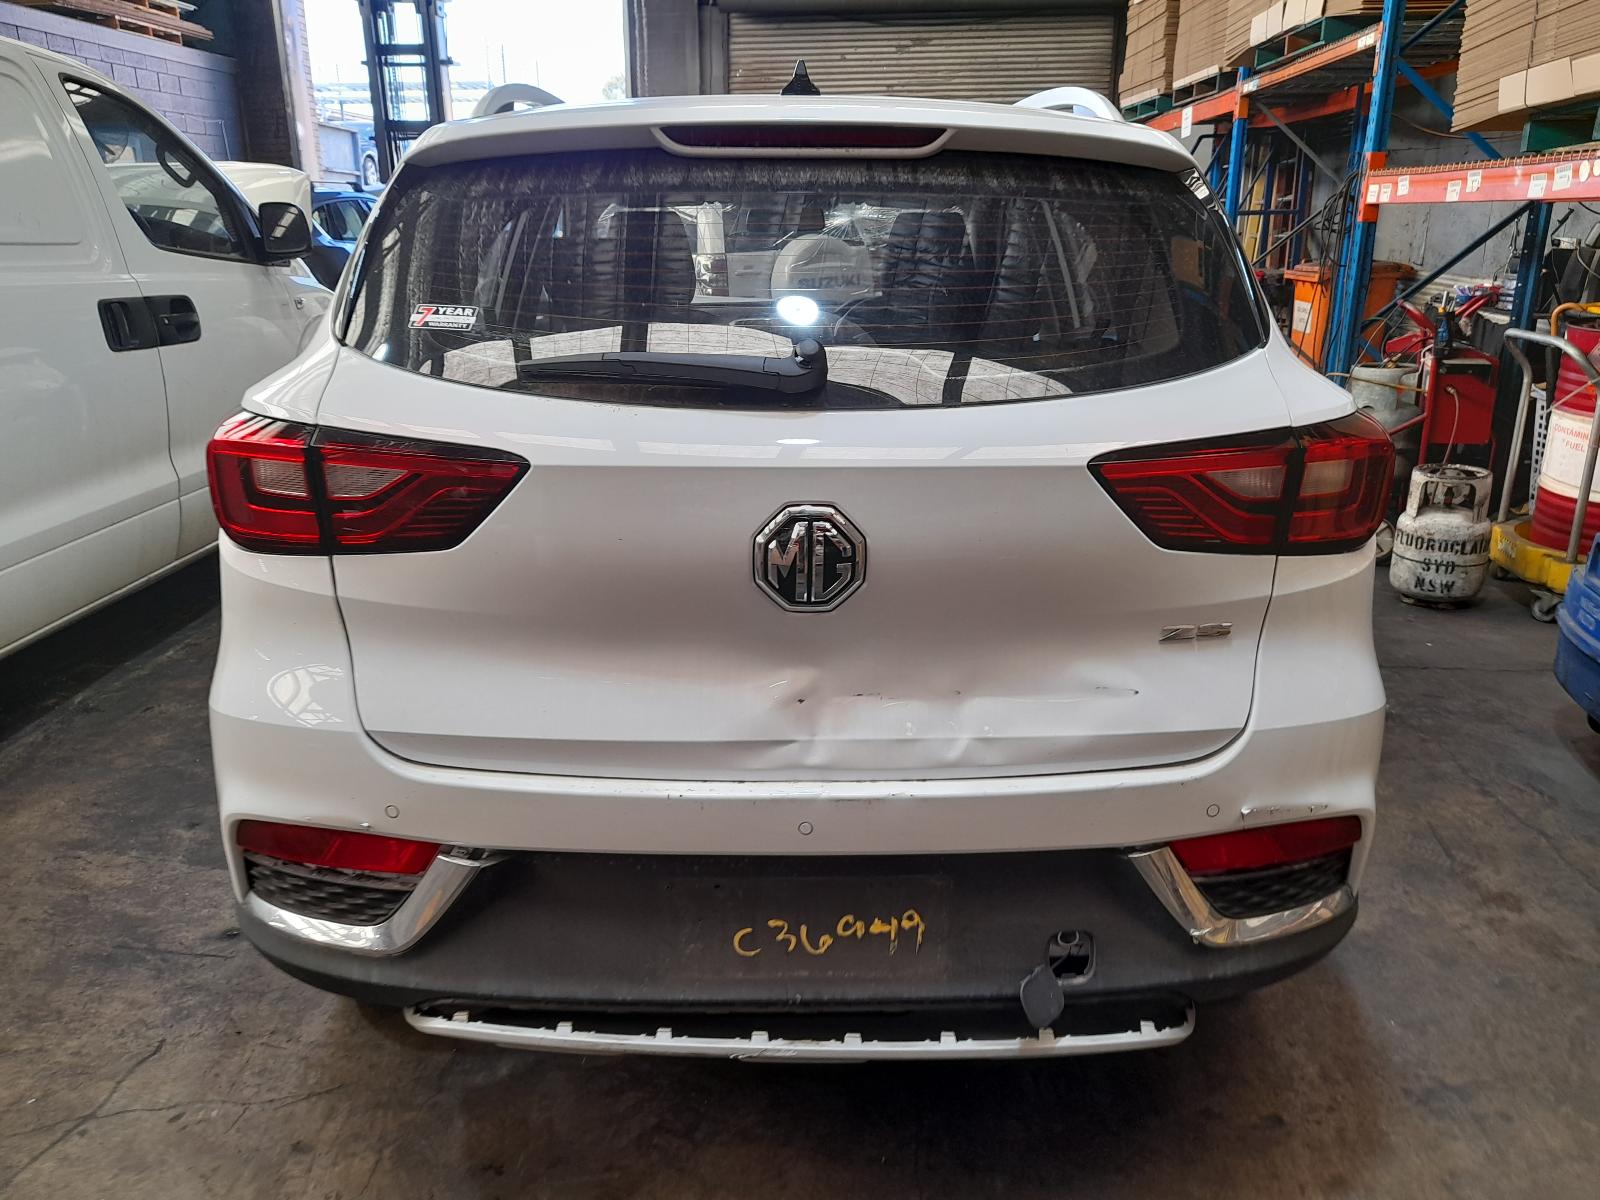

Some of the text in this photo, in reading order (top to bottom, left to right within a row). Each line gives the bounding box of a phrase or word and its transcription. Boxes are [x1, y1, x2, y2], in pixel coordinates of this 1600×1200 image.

[798, 274, 861, 289] SUZUKI
[413, 306, 437, 327] 7
[438, 306, 474, 317] YEAR
[428, 321, 468, 329] WARRANTY
[1553, 423, 1589, 440] CONTAMIN
[1565, 440, 1585, 452] FUEL
[768, 521, 852, 602] MG
[1422, 557, 1456, 575] SYD
[1414, 576, 1456, 594] NSW
[1159, 622, 1233, 641] ZS
